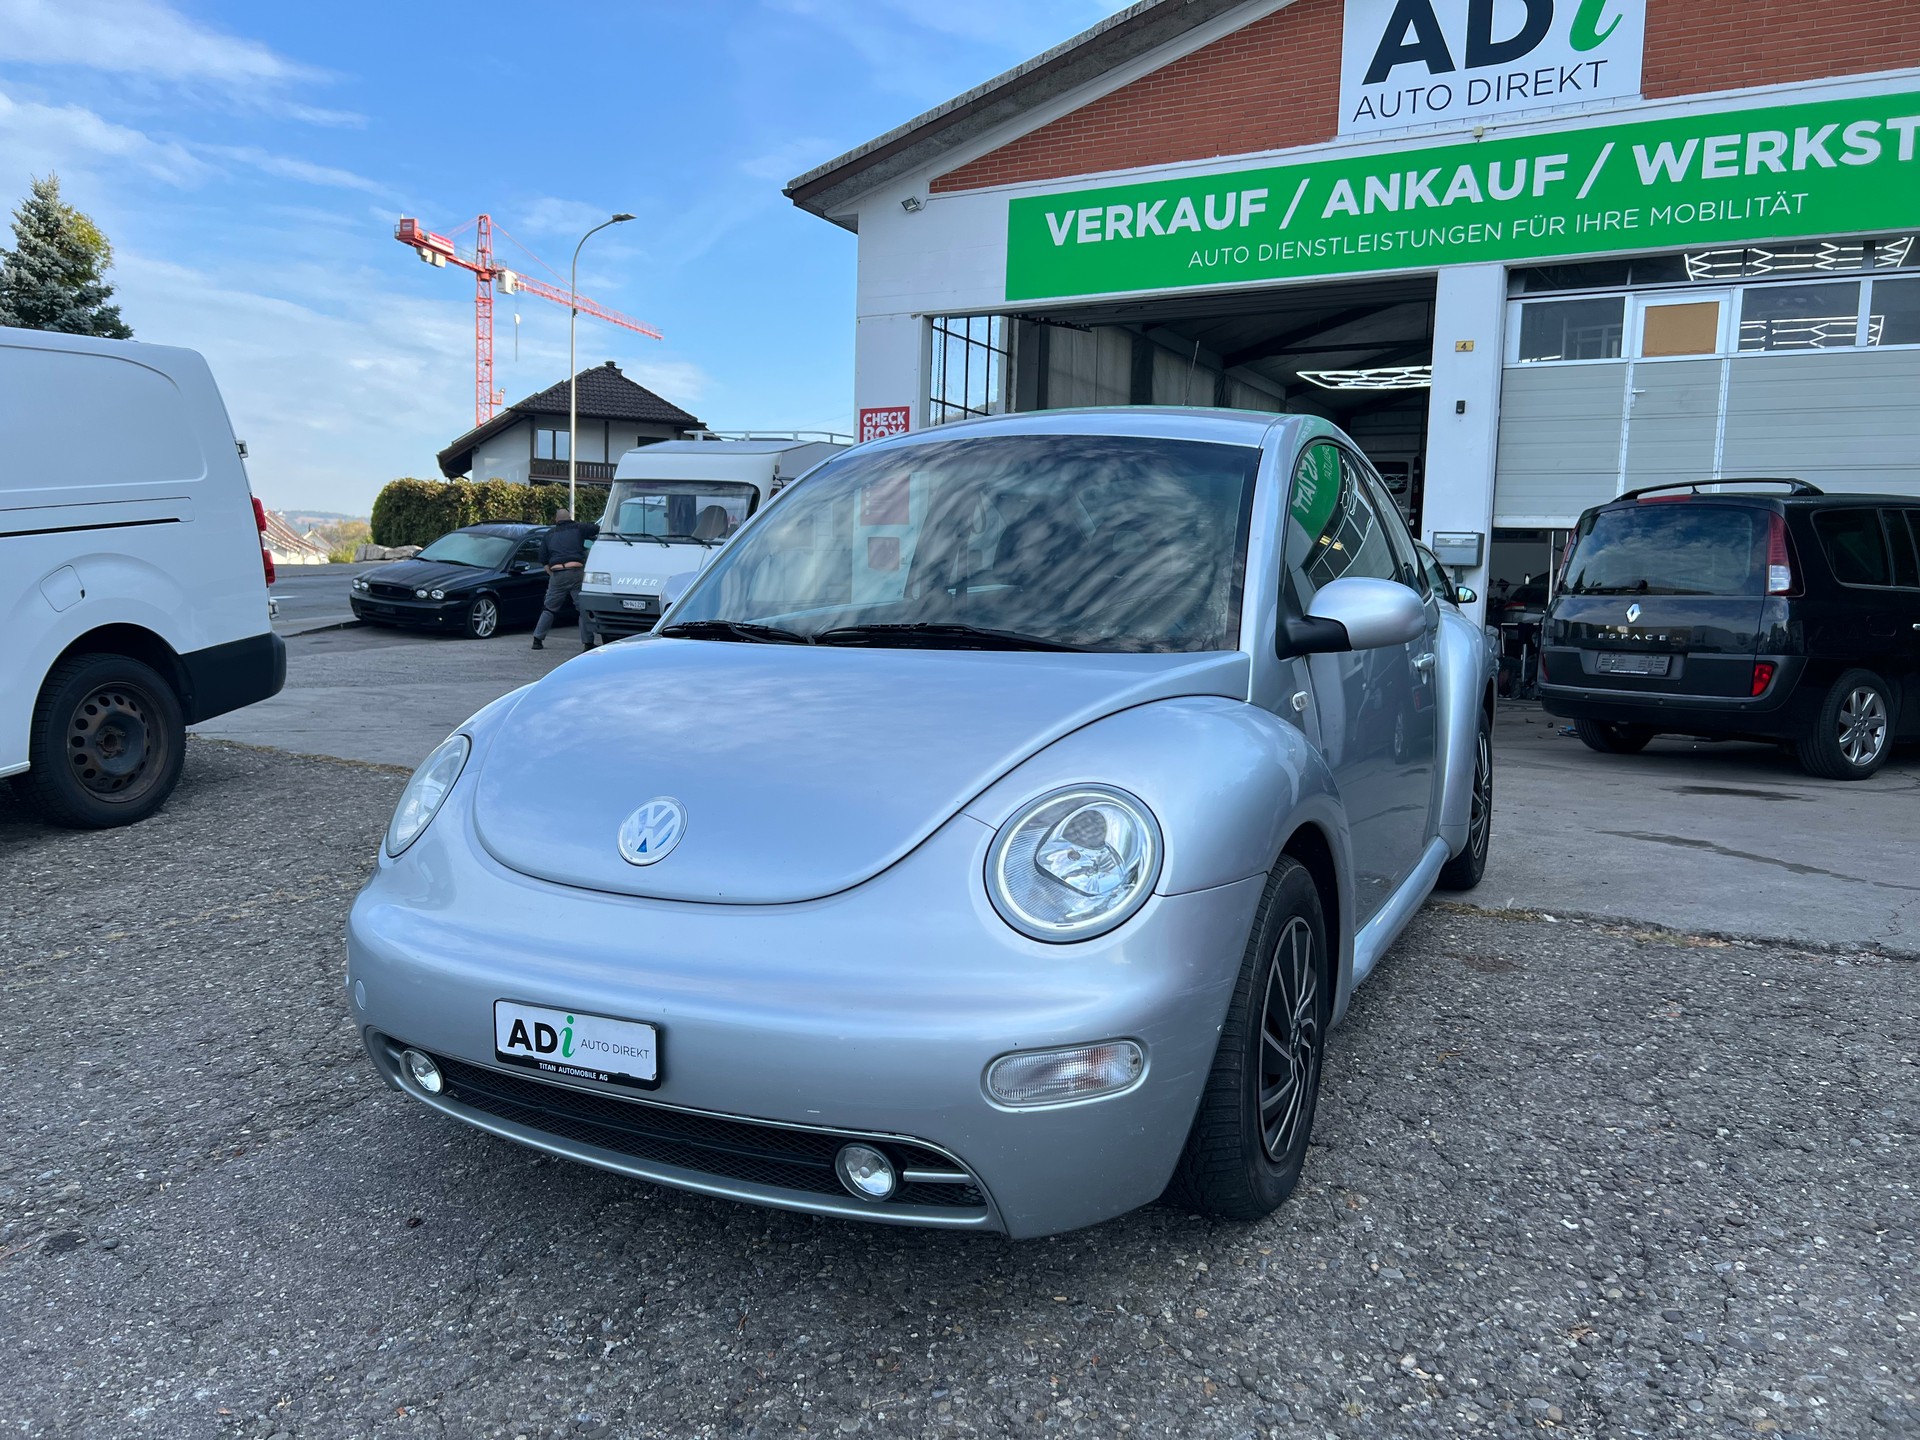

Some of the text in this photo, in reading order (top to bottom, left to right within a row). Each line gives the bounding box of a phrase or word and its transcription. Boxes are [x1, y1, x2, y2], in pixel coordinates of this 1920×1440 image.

[1352, 59, 1609, 123] AUTO DIREKT
[1044, 187, 1269, 247] VERKAUF
[1320, 153, 1569, 219] ANKAUF
[1631, 114, 1920, 186] WERKST
[1187, 190, 1809, 269] AUTO DIENSTLEISTUNGEN FÜR IHRE MOBILITÄT
[863, 411, 906, 426] CHECK
[617, 577, 658, 587] HYMER
[1597, 633, 1667, 641] ESPACE
[580, 1038, 610, 1053] AUTO
[612, 1043, 650, 1060] DIREKT
[539, 1062, 609, 1082] TITAN AUTOMOBILE AG
